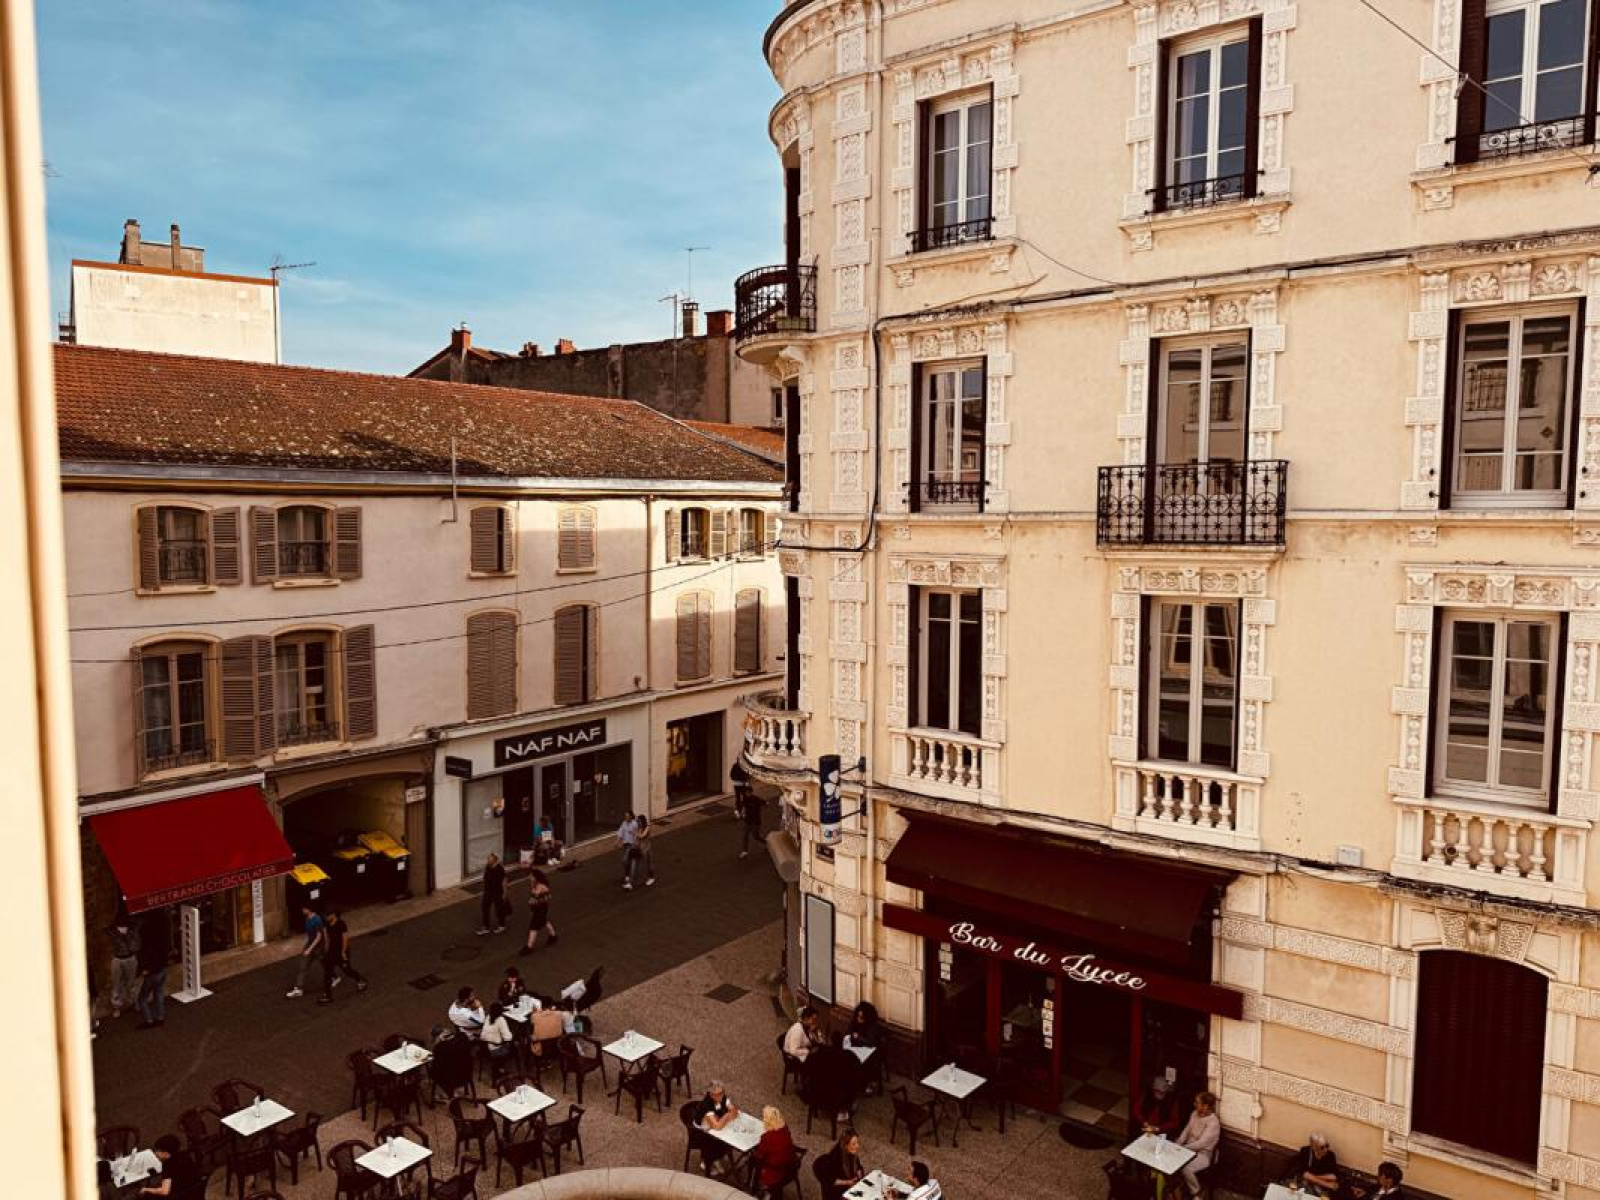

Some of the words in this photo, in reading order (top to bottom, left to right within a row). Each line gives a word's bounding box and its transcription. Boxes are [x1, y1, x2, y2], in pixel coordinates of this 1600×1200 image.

[505, 738, 553, 759] NAF
[557, 727, 601, 748] NAF
[948, 922, 1003, 952] Bar
[1014, 942, 1050, 966] du
